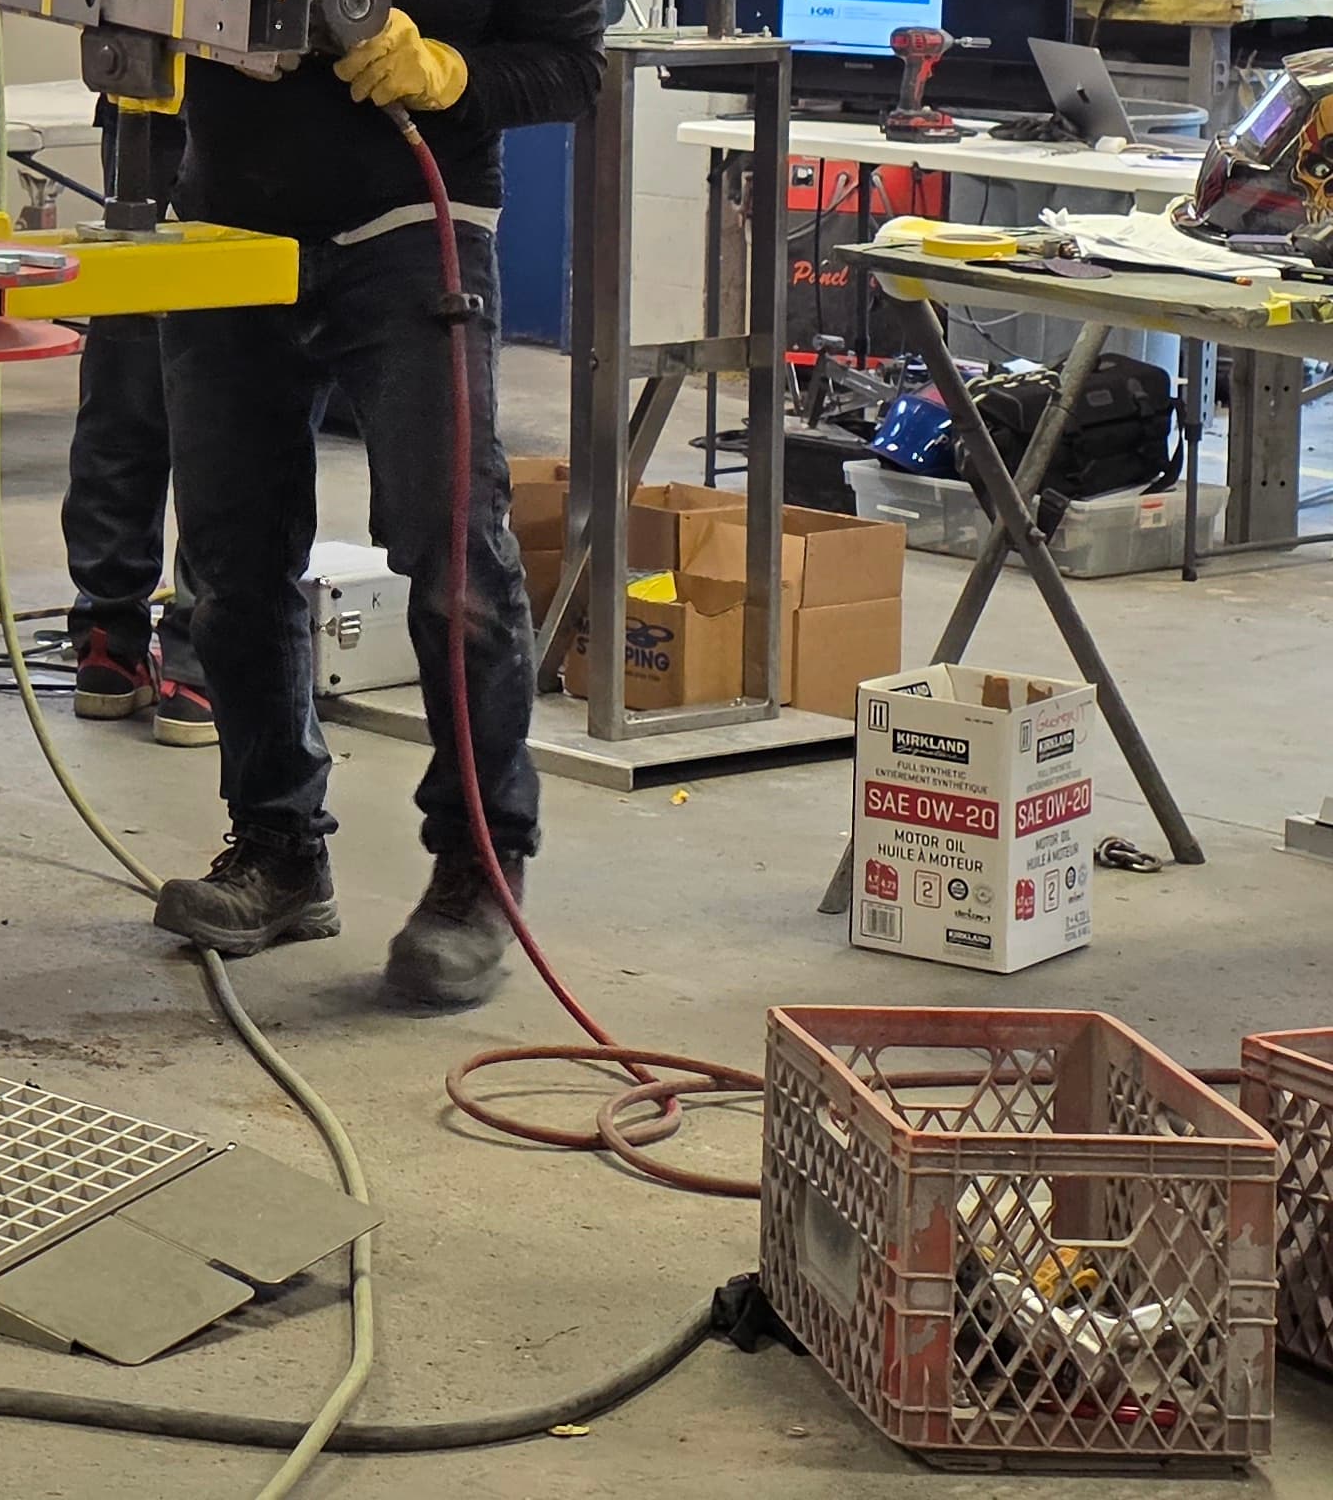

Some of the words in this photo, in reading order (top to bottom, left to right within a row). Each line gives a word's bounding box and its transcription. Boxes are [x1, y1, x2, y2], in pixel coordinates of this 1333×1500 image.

[896, 731, 967, 755] KIRKLAND
[897, 760, 917, 772] FULL
[919, 763, 968, 780] SYNTHETIC
[868, 788, 910, 815] SAE
[916, 796, 996, 831] 0W-20
[1018, 799, 1044, 831] SAE
[894, 829, 939, 848] MOTOR
[946, 838, 966, 854] OIL
[878, 843, 915, 861] HUILE
[929, 855, 984, 874] MOTEUR
[922, 880, 933, 899] 2
[1048, 881, 1055, 901] 2
